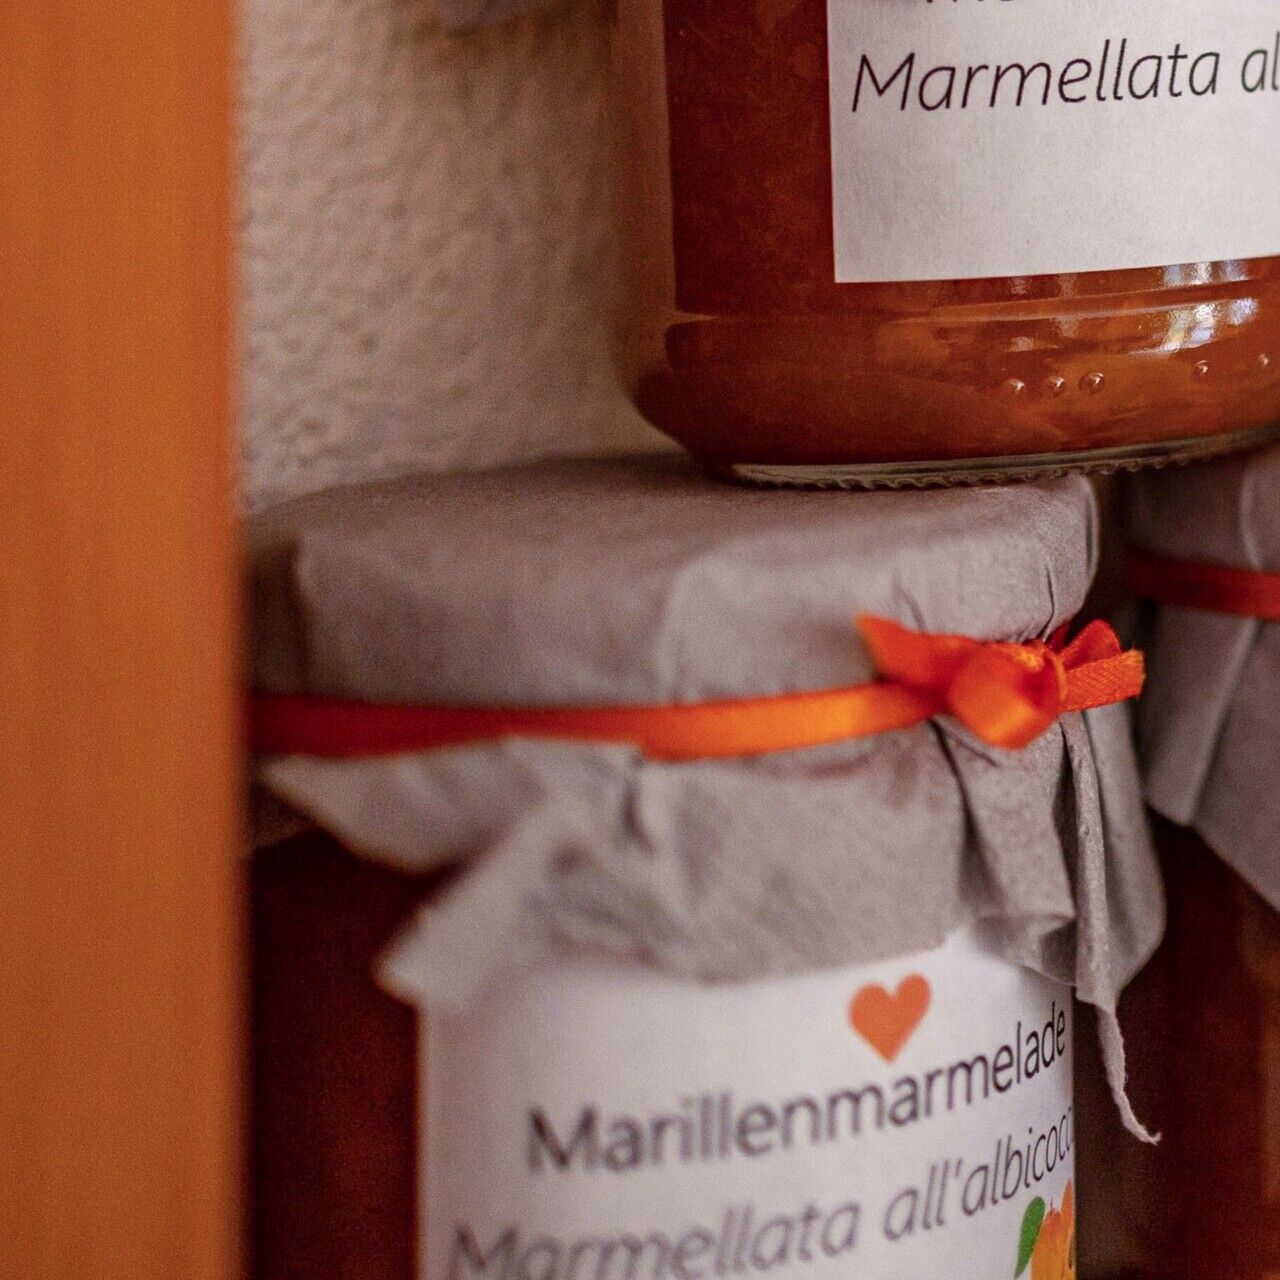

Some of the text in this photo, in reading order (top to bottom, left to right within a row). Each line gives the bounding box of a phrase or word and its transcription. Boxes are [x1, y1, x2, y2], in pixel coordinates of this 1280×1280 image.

[852, 38, 1220, 113] Marmellata
[524, 1000, 1066, 1174] Marillenmarmelade
[448, 1202, 862, 1280] Marmellata
